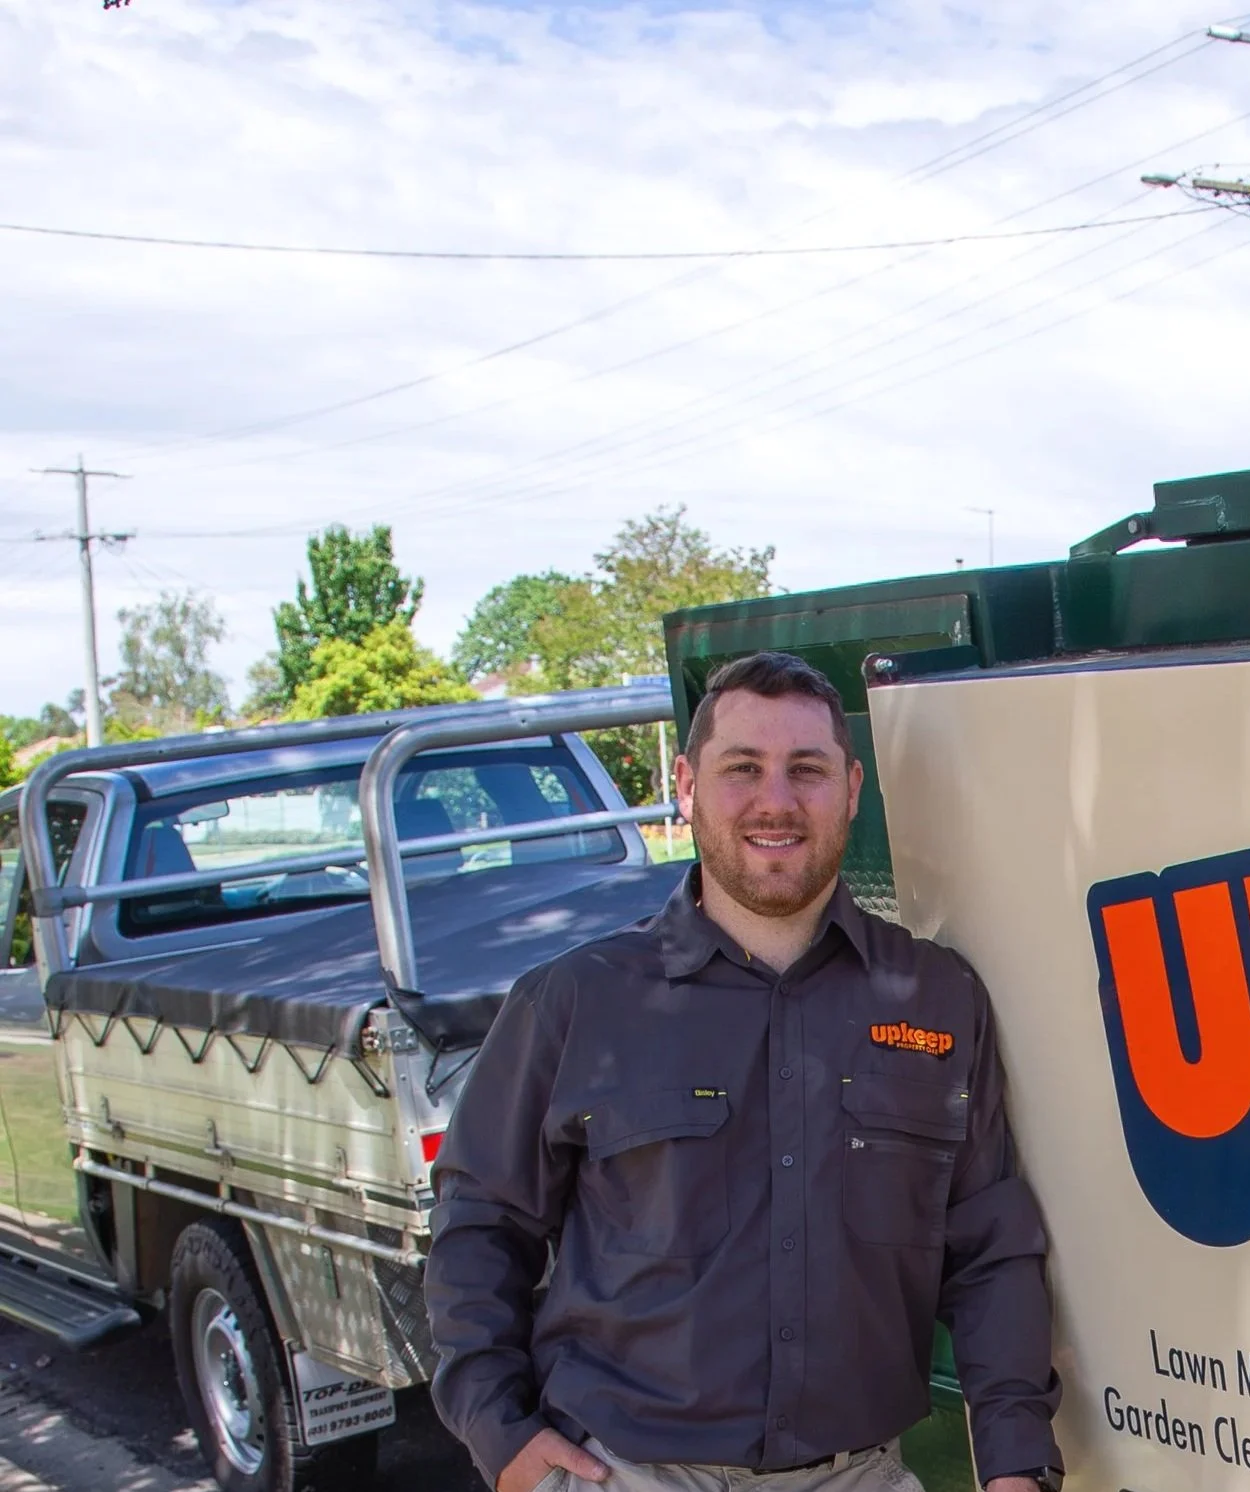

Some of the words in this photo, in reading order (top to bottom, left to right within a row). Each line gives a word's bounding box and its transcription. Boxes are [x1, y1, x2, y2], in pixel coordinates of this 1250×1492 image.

[871, 1022, 953, 1054] upkeep
[1149, 1328, 1227, 1392] Lawn
[1104, 1386, 1206, 1456] Garden
